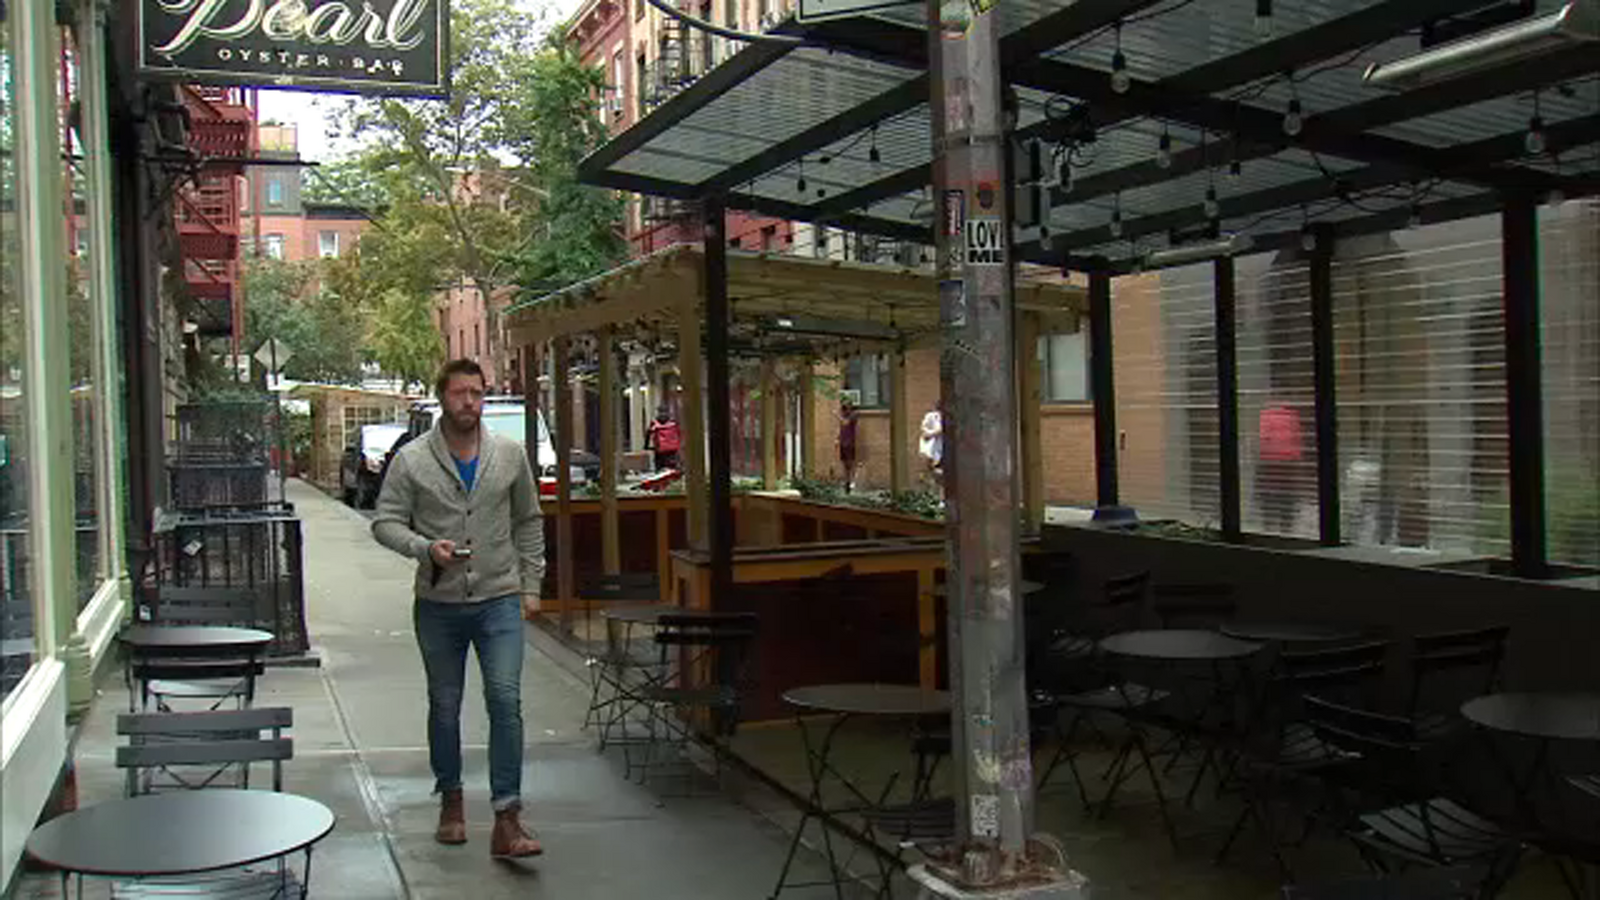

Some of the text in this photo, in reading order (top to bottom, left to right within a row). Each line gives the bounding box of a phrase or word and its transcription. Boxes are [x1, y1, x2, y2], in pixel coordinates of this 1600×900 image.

[217, 48, 404, 76] OYSTER BAR
[969, 249, 1005, 263] ME
